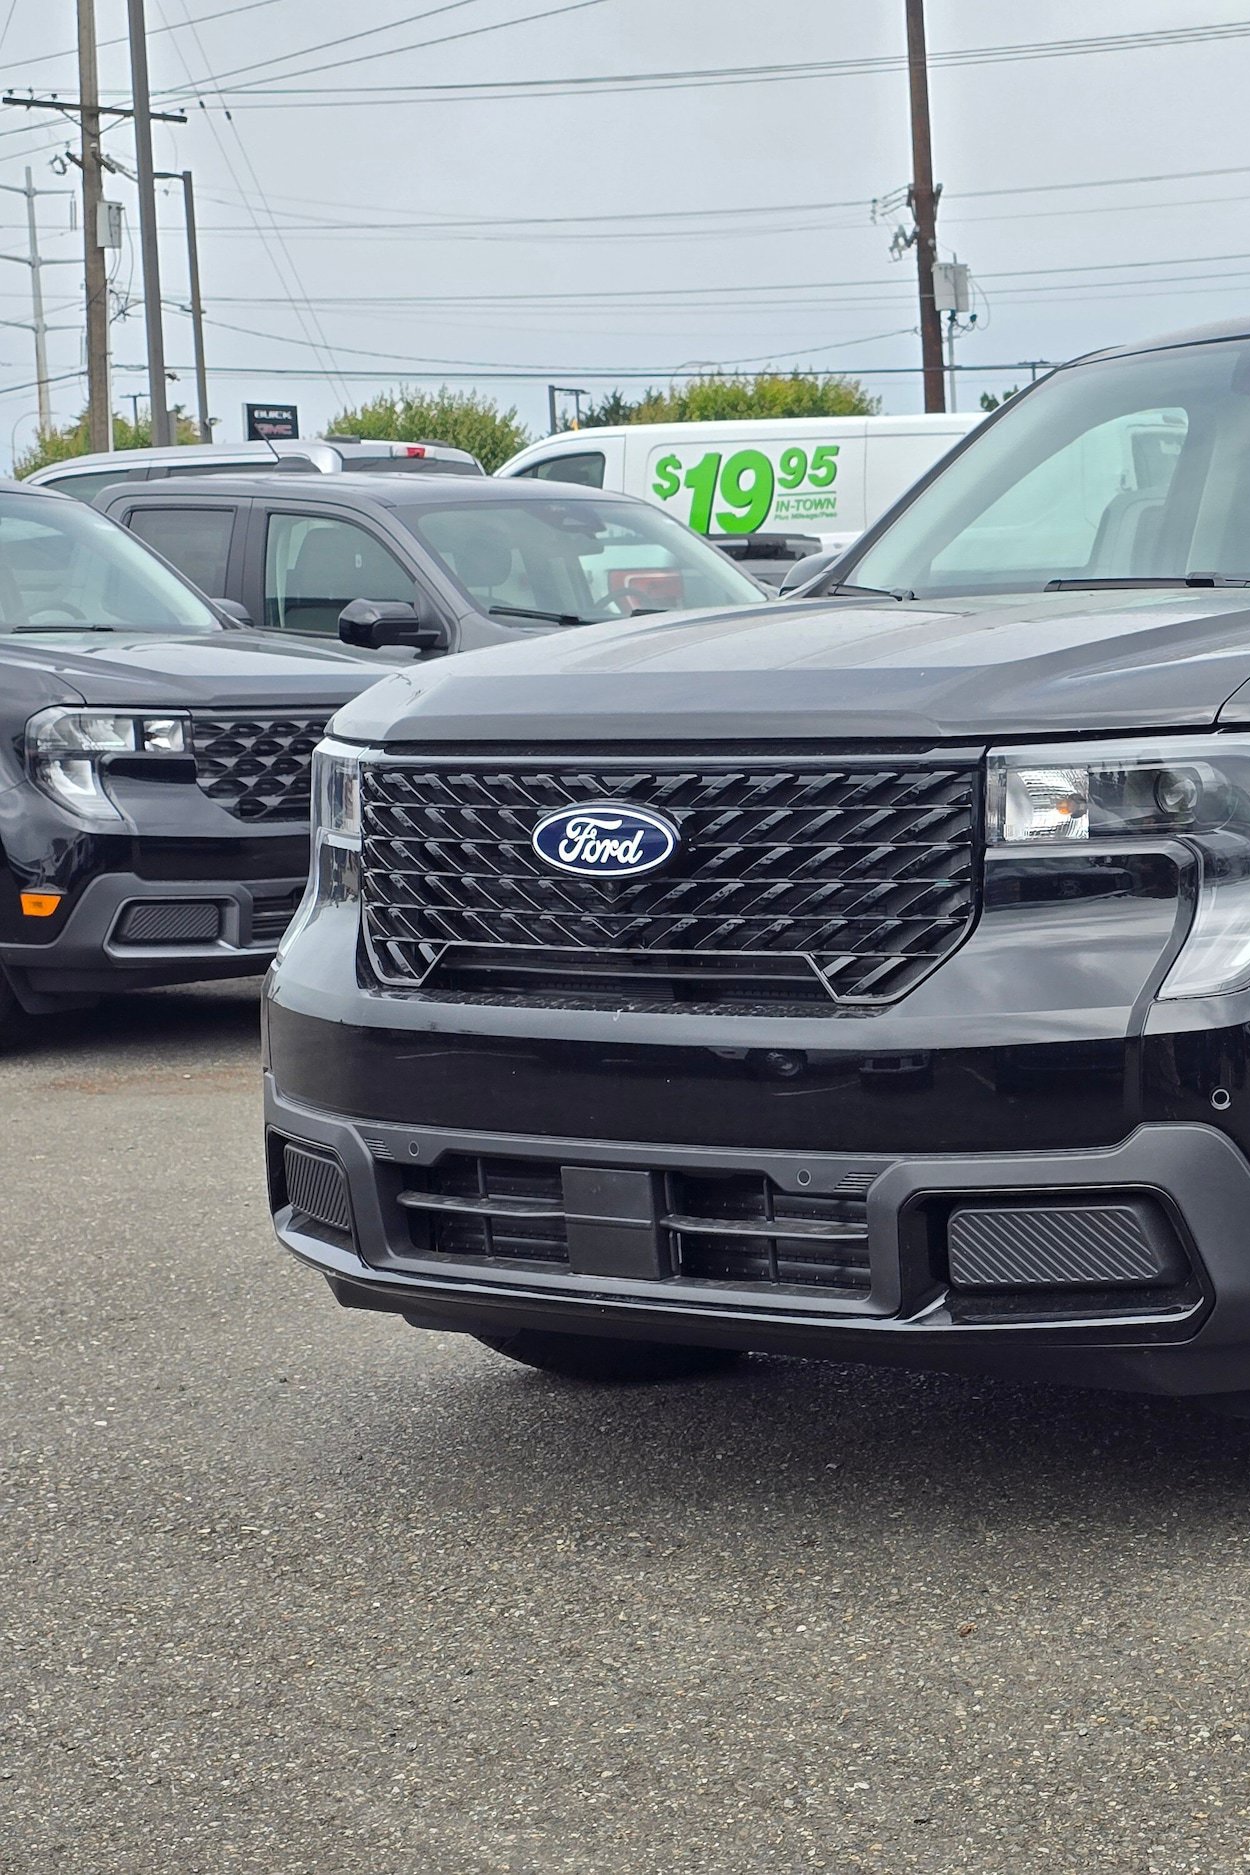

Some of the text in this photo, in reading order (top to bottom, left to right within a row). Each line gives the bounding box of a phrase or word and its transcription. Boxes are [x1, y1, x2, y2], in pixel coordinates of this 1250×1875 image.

[254, 409, 292, 419] BUICK
[775, 497, 837, 512] IN-TOWN
[558, 817, 645, 864] Ford
